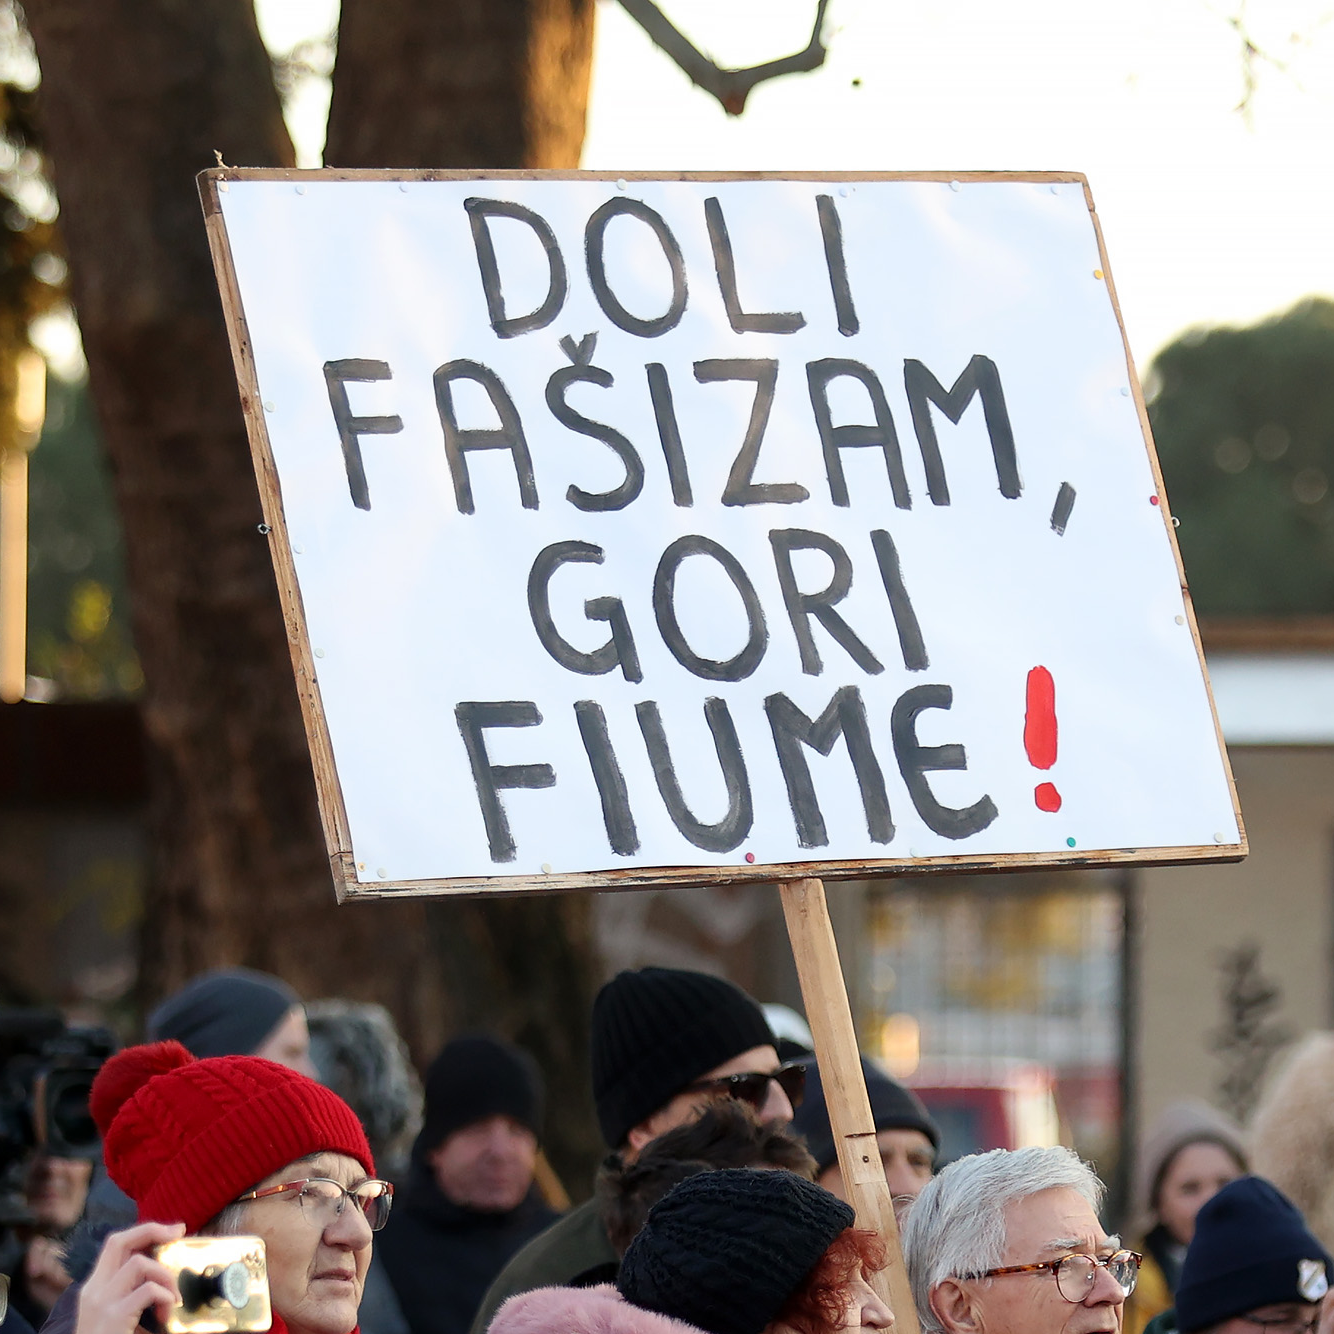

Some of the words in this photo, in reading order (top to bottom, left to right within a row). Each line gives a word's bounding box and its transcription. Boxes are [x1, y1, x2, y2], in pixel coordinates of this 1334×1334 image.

[463, 194, 860, 340] DOLI
[322, 331, 1077, 536] FAŠIZAM,
[526, 527, 931, 685] GORI
[453, 664, 1062, 863] FIUME!
